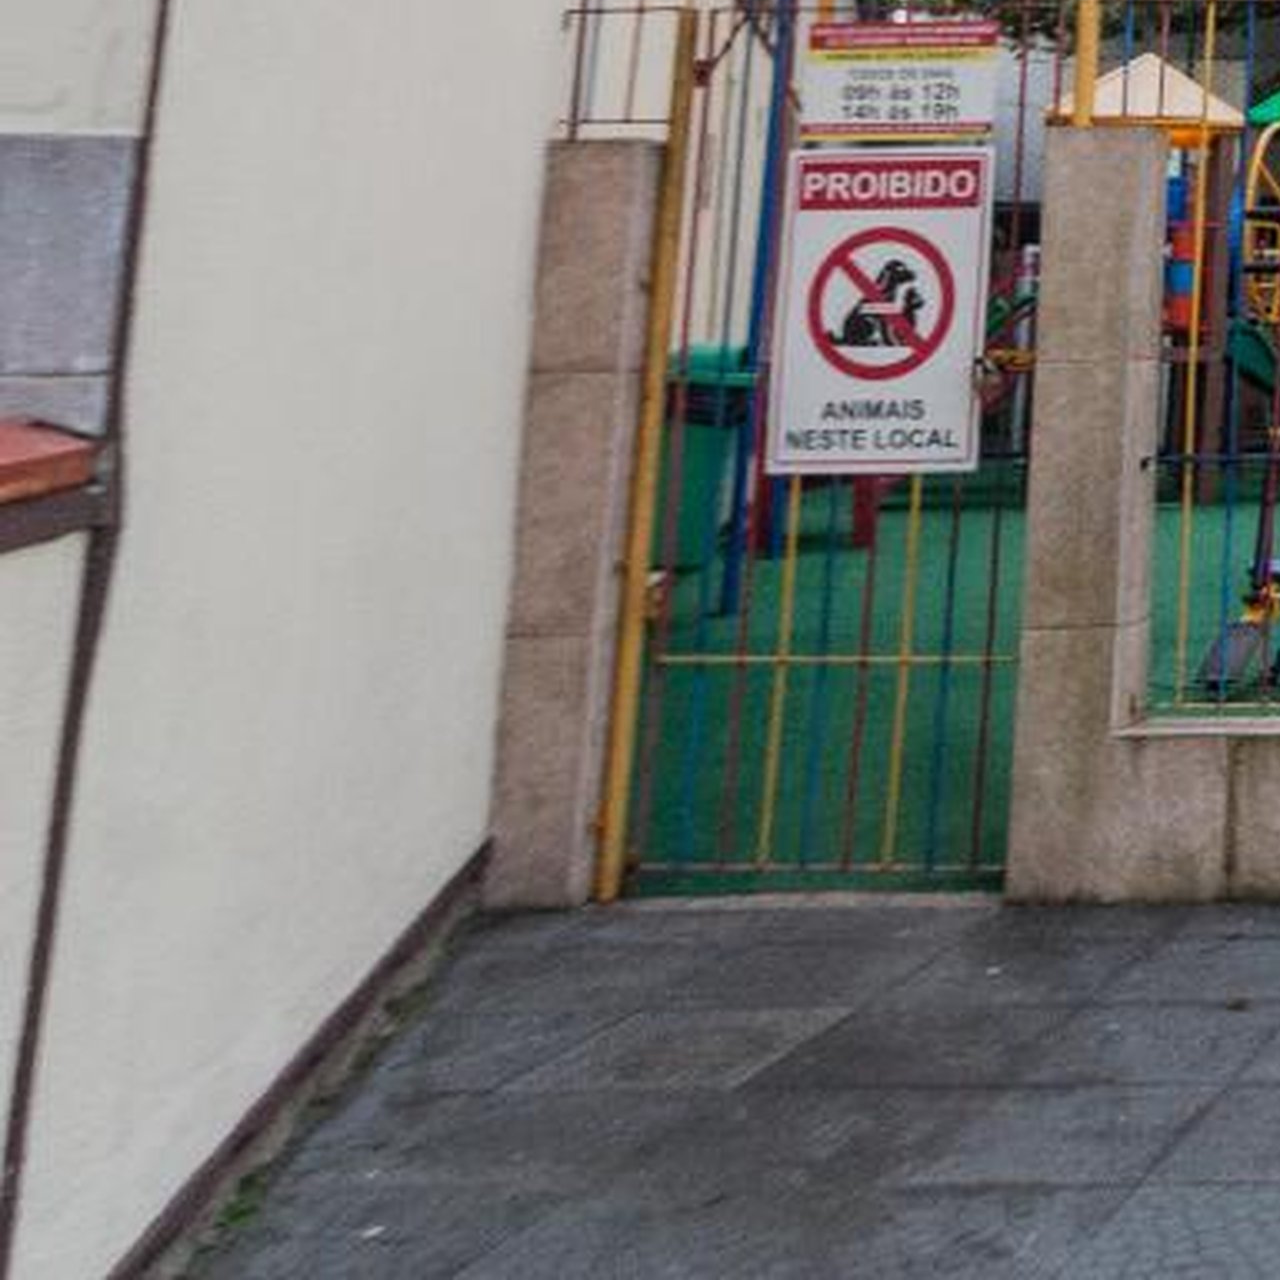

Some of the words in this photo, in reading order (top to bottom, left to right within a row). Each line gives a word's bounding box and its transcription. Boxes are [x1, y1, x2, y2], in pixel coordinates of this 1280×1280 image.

[802, 169, 977, 201] PROIBIDO
[821, 399, 926, 421] ANIMAIS
[786, 429, 868, 450] NESTE
[873, 428, 959, 449] LOCAL
